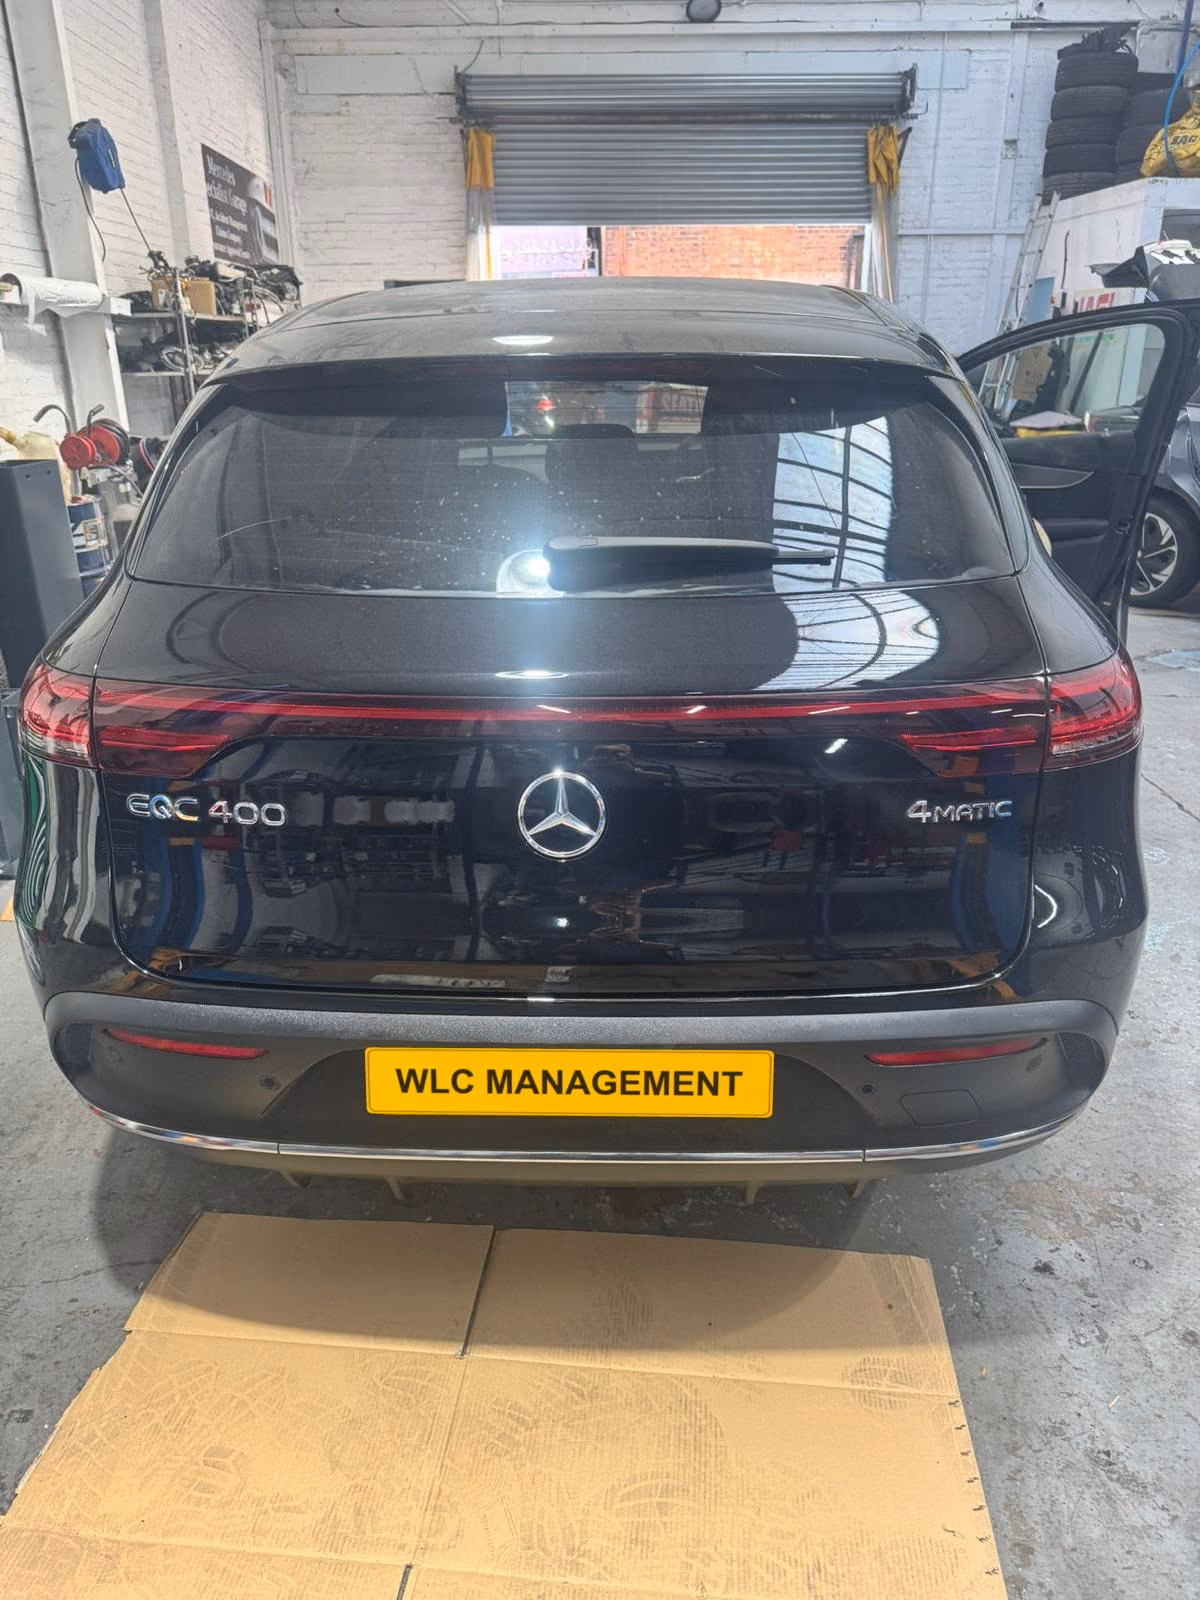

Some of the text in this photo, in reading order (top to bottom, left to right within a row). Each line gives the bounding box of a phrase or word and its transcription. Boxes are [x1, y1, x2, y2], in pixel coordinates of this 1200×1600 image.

[126, 793, 287, 827] EQC 400
[906, 799, 1013, 824] 4MATIC
[395, 1067, 744, 1097] WLC MANAGEMENT
